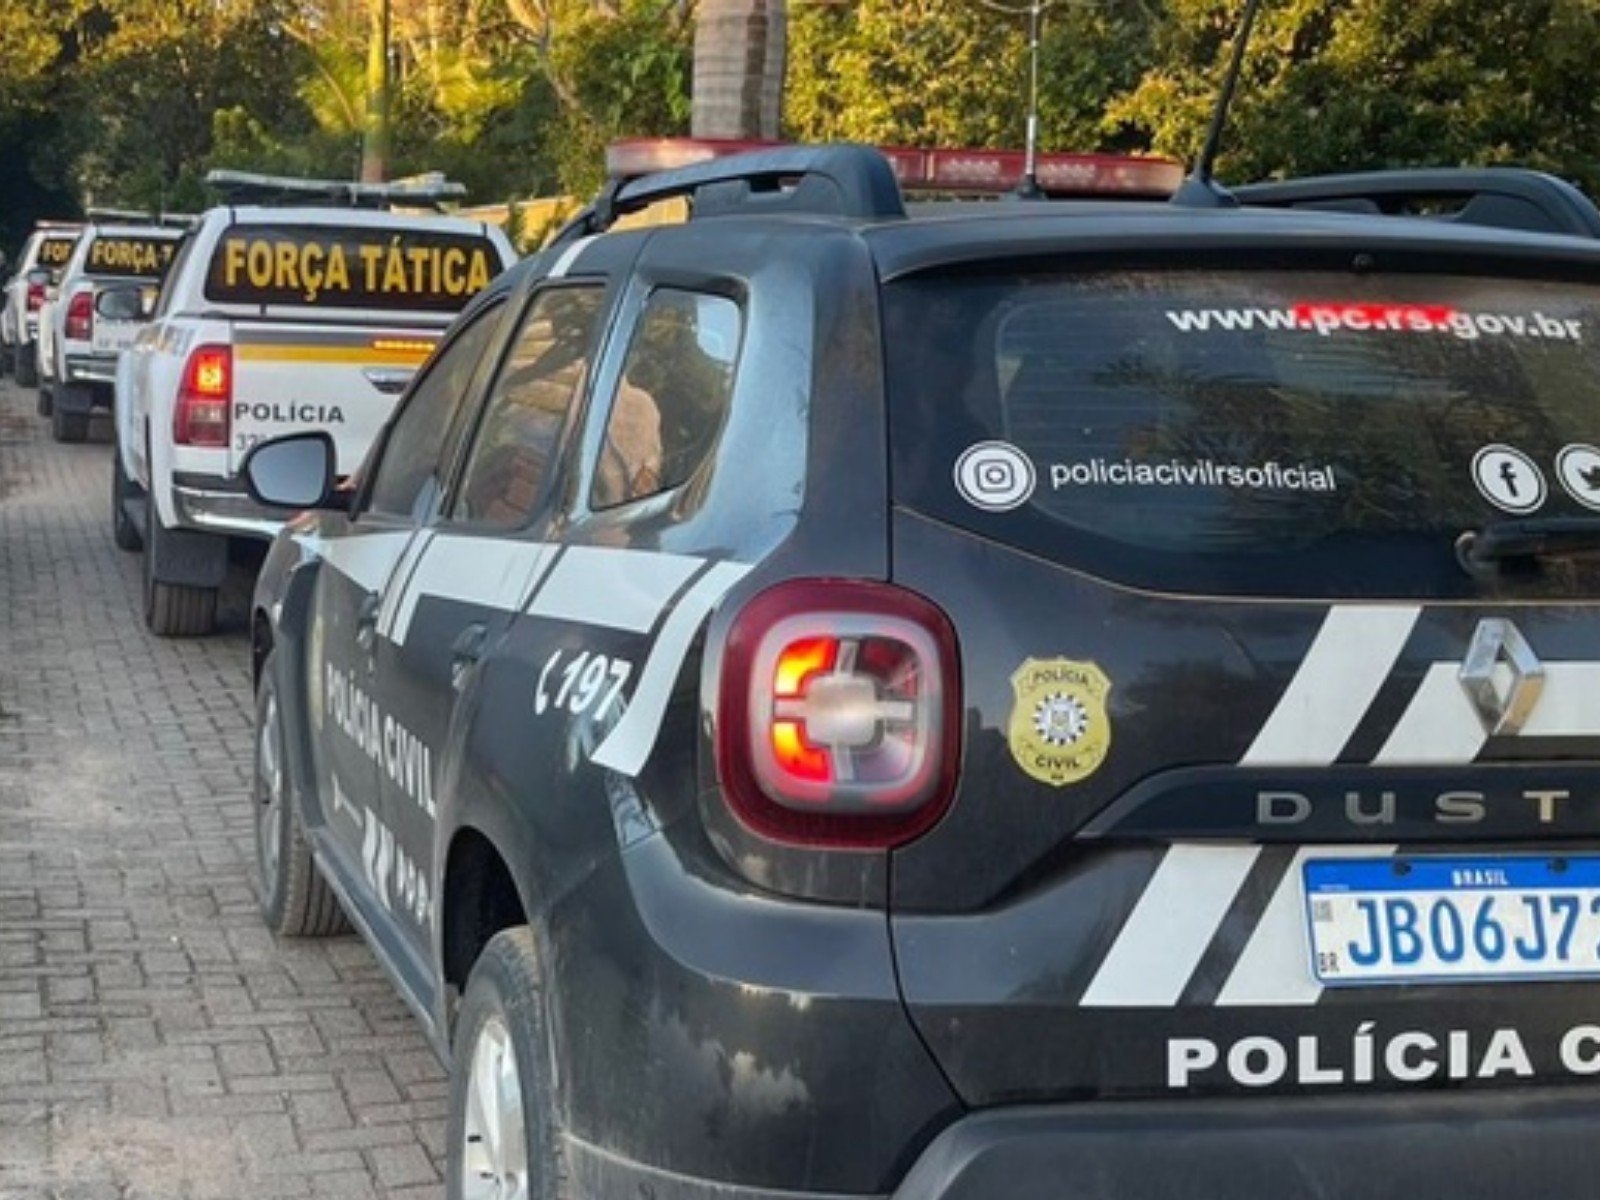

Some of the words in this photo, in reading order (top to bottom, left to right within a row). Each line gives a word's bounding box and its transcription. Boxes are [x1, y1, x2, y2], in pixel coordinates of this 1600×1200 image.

[92, 240, 157, 274] FORÇA
[225, 239, 349, 302] FORÇA
[360, 235, 489, 296] TÁTICA
[1166, 306, 1583, 340] www.pc.rs.gov.br
[235, 402, 345, 423] POLÍCIA
[1050, 460, 1336, 493] policiacivilrsoficial
[554, 650, 633, 721] 197
[327, 660, 383, 767] POLÍCIA
[383, 713, 437, 820] CIVIL
[1034, 753, 1080, 768] CIVIL
[1256, 791, 1570, 824] DUST
[1452, 869, 1508, 887] BRASIL
[1166, 1021, 1535, 1088] POLÍCIA
